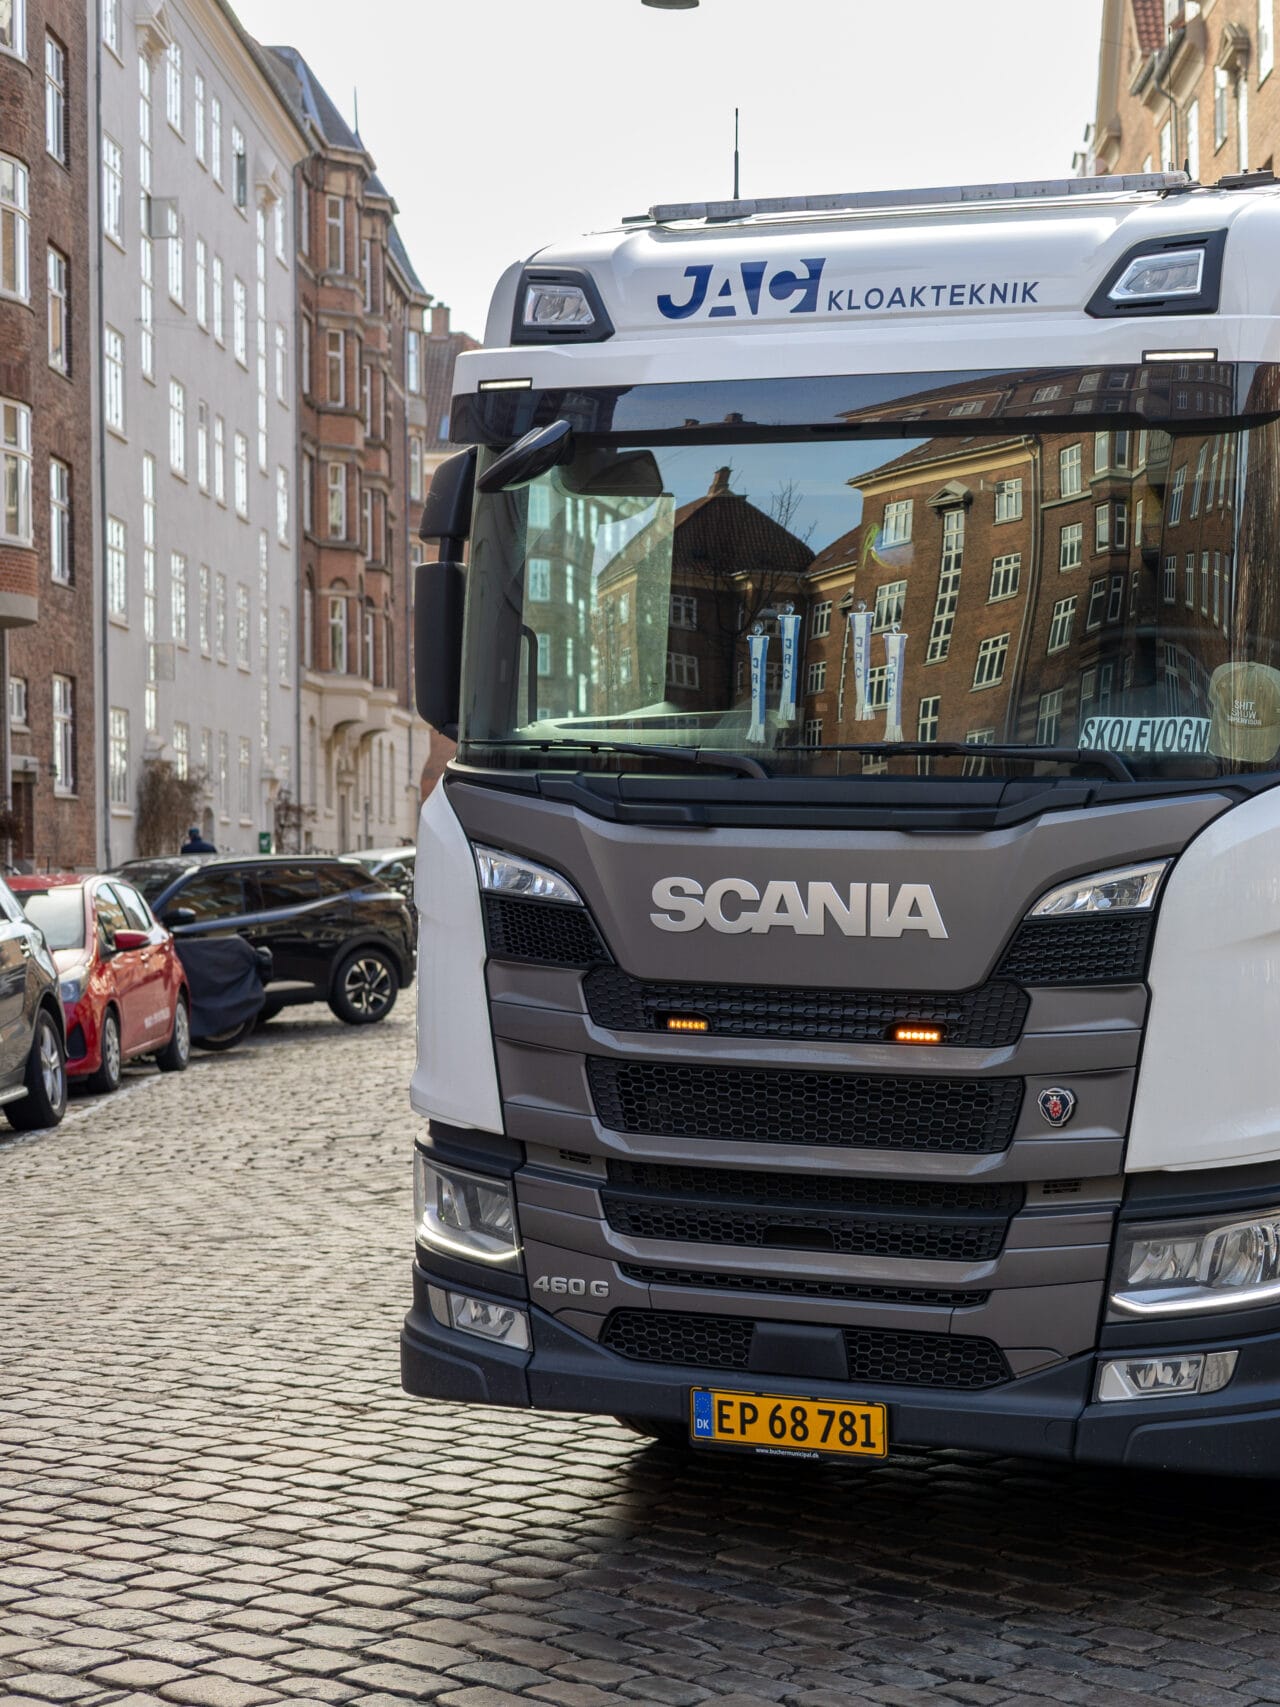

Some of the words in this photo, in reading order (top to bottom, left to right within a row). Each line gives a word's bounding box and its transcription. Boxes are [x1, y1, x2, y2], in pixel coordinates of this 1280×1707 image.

[657, 258, 826, 319] JAC
[827, 281, 1040, 312] KLOAKTEKNIK
[1234, 699, 1256, 711] SHIT
[1081, 717, 1212, 752] SKOLEVOGN
[650, 876, 949, 939] SCANIA
[533, 1275, 586, 1296] 460
[590, 1280, 609, 1298] G
[696, 1418, 709, 1430] DK
[717, 1400, 759, 1436] EP
[768, 1403, 809, 1442] 68
[817, 1408, 876, 1448] 781
